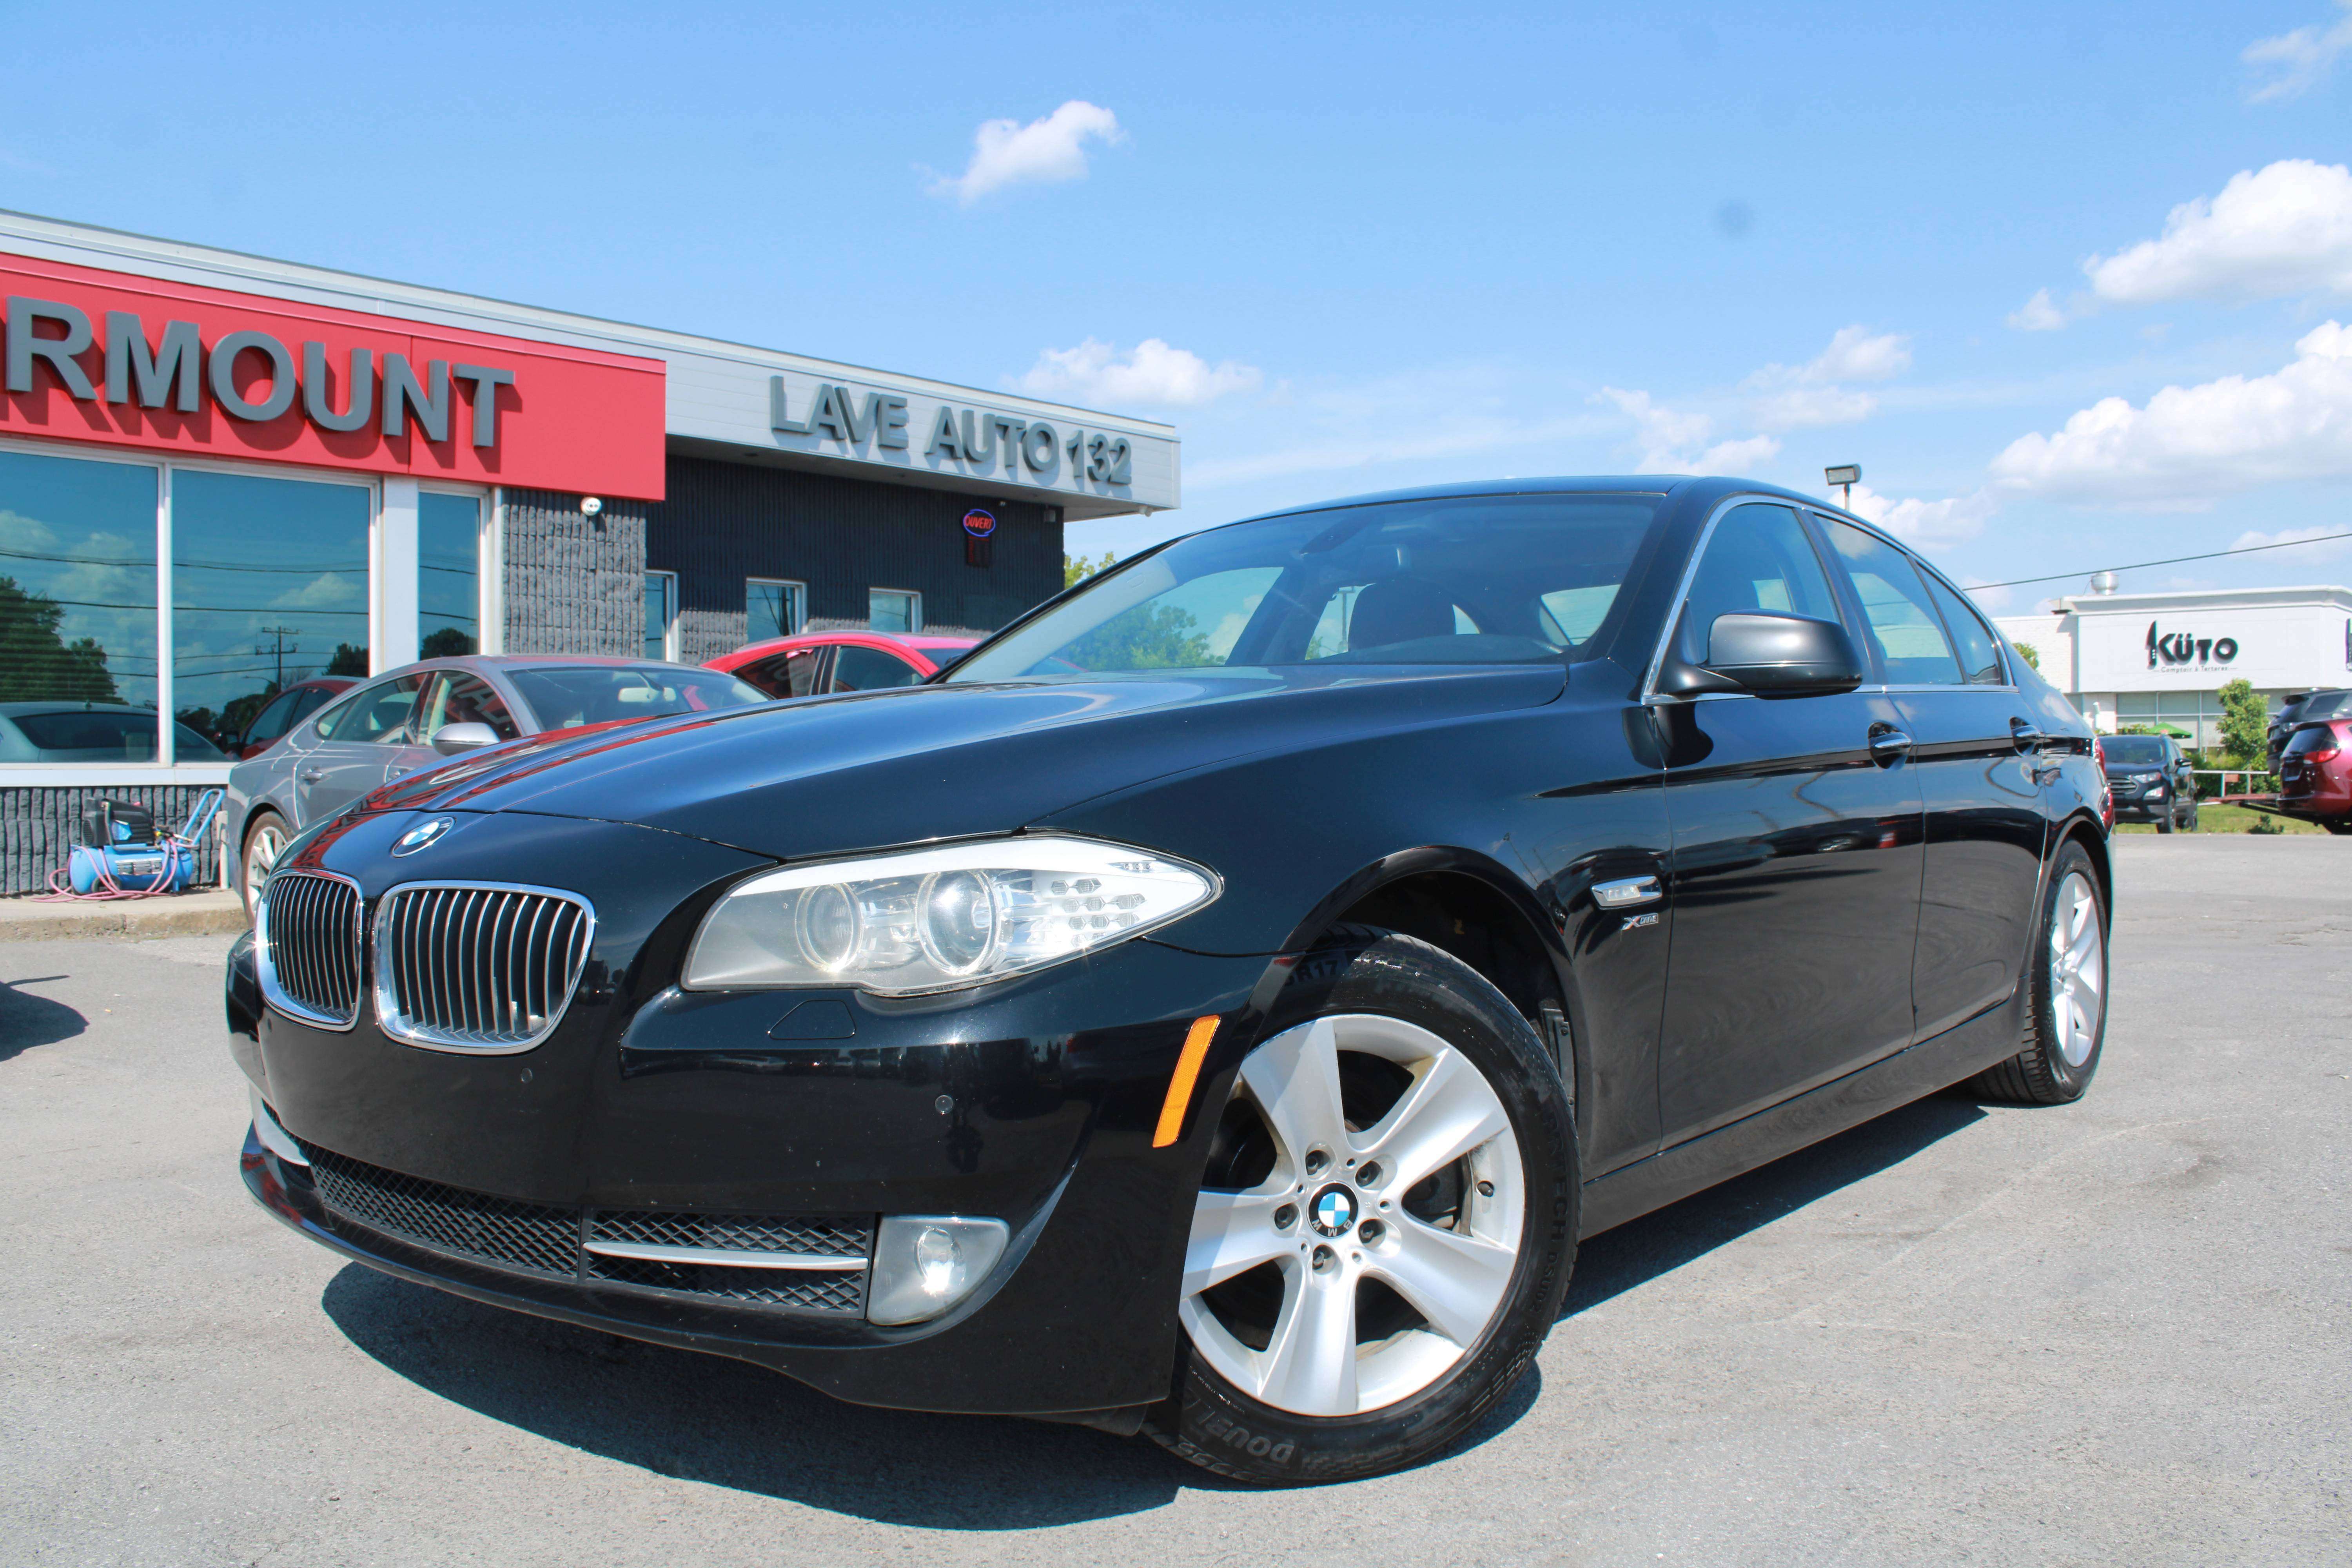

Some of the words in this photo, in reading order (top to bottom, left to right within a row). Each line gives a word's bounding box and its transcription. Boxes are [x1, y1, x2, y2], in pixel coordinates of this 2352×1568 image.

[6, 295, 515, 448] RMOUNT
[770, 375, 908, 449] LAVE
[925, 406, 1059, 472] AUTO
[1067, 430, 1132, 485] 132
[965, 515, 992, 529] OUVERT
[1312, 1219, 1353, 1237] BMW
